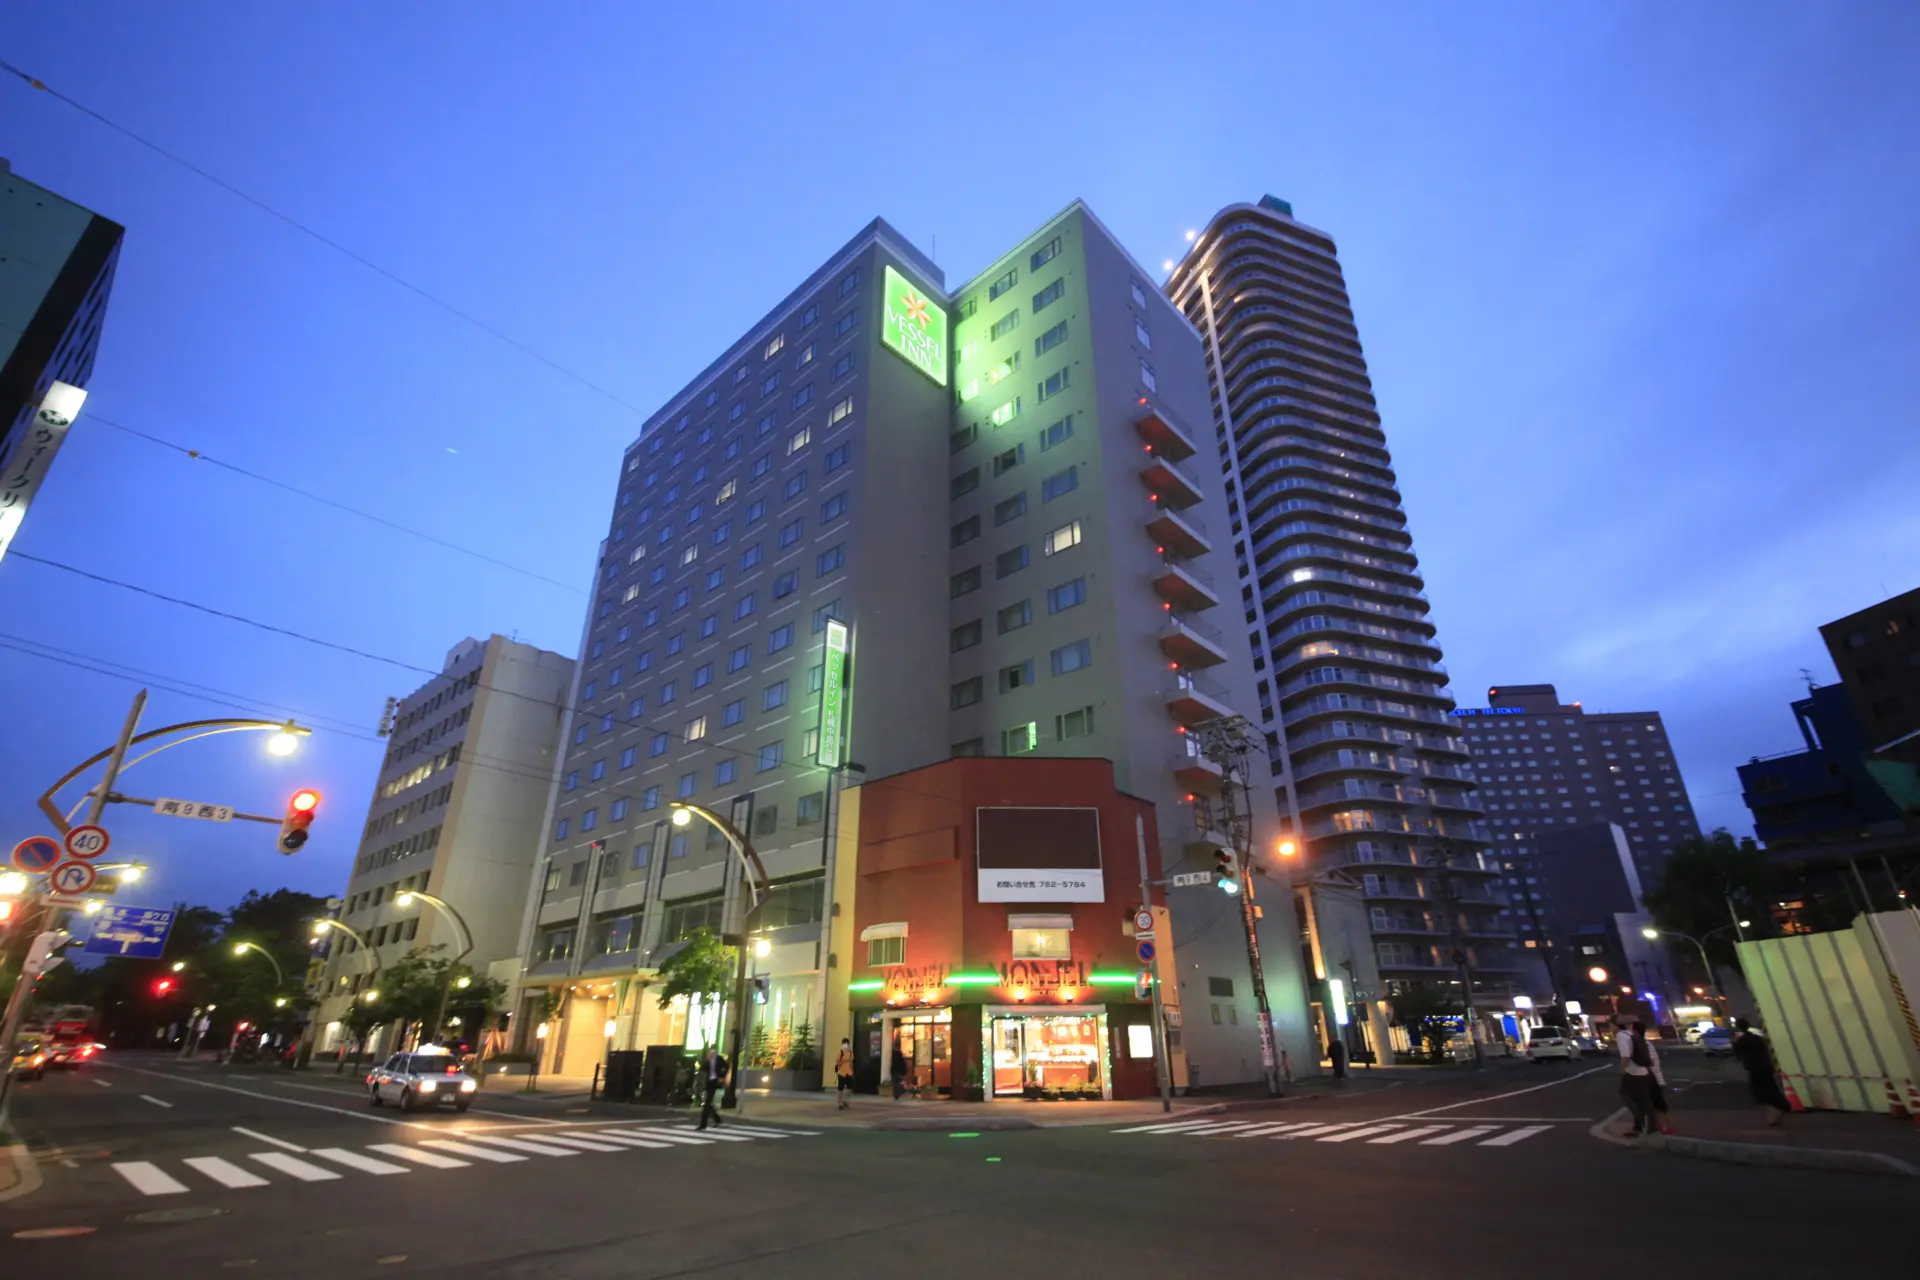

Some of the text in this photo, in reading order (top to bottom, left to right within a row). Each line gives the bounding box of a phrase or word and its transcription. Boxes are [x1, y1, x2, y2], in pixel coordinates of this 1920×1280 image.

[887, 304, 945, 363] VESSEL
[901, 335, 933, 371] INN
[0, 429, 52, 520] ウィークリ
[827, 653, 840, 706] ベッセルイン
[74, 834, 100, 850] 40
